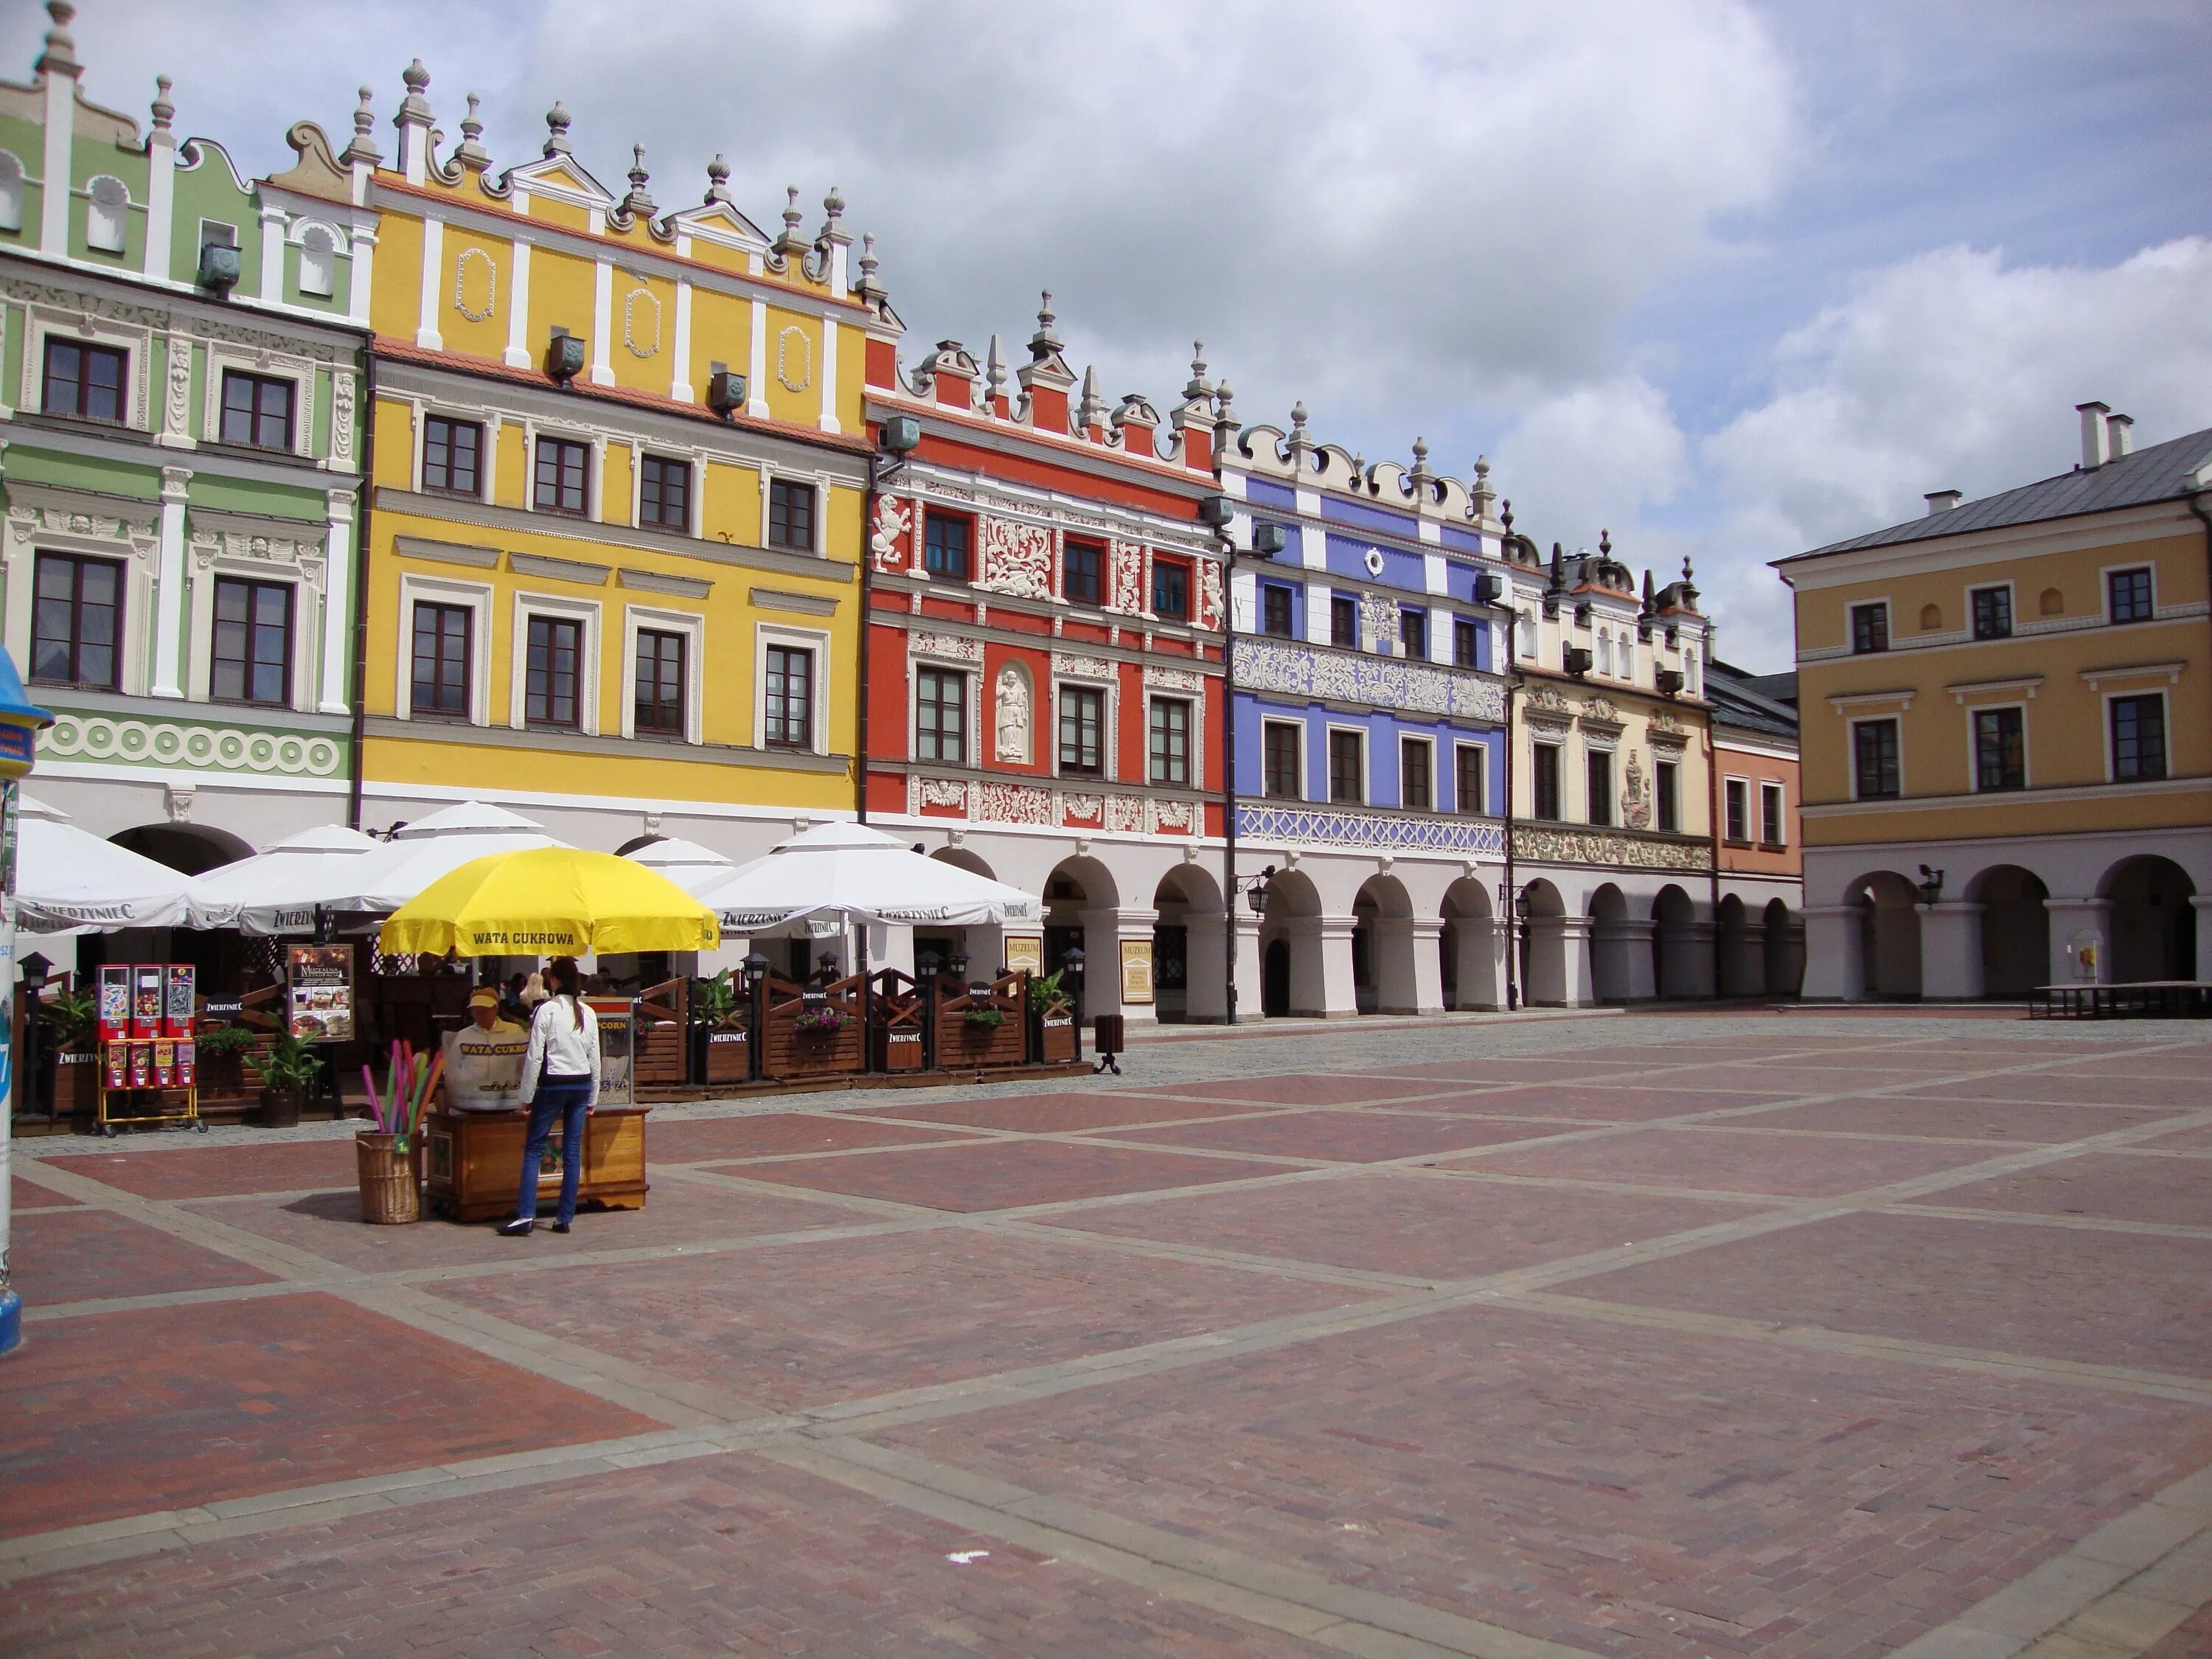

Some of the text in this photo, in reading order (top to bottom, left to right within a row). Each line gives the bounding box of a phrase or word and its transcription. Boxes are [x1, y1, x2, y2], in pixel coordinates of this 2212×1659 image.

[875, 905, 950, 920] ZWIERZYNIEC
[1003, 902, 1027, 917] ZWIERZYNIEC
[473, 932, 574, 945] WATA CUKROWA
[1009, 944, 1039, 952] MUZEUM
[1124, 947, 1150, 955] MUZEUM
[206, 1003, 243, 1011] ZWIERZYNIEC
[598, 1021, 626, 1029] CORN
[1044, 1017, 1072, 1027] ZWIERZYNIEC
[710, 1032, 746, 1043] ZWIERZYNIEC
[889, 1034, 920, 1043] ZWIERZYNIEC
[460, 1044, 491, 1054] WATA
